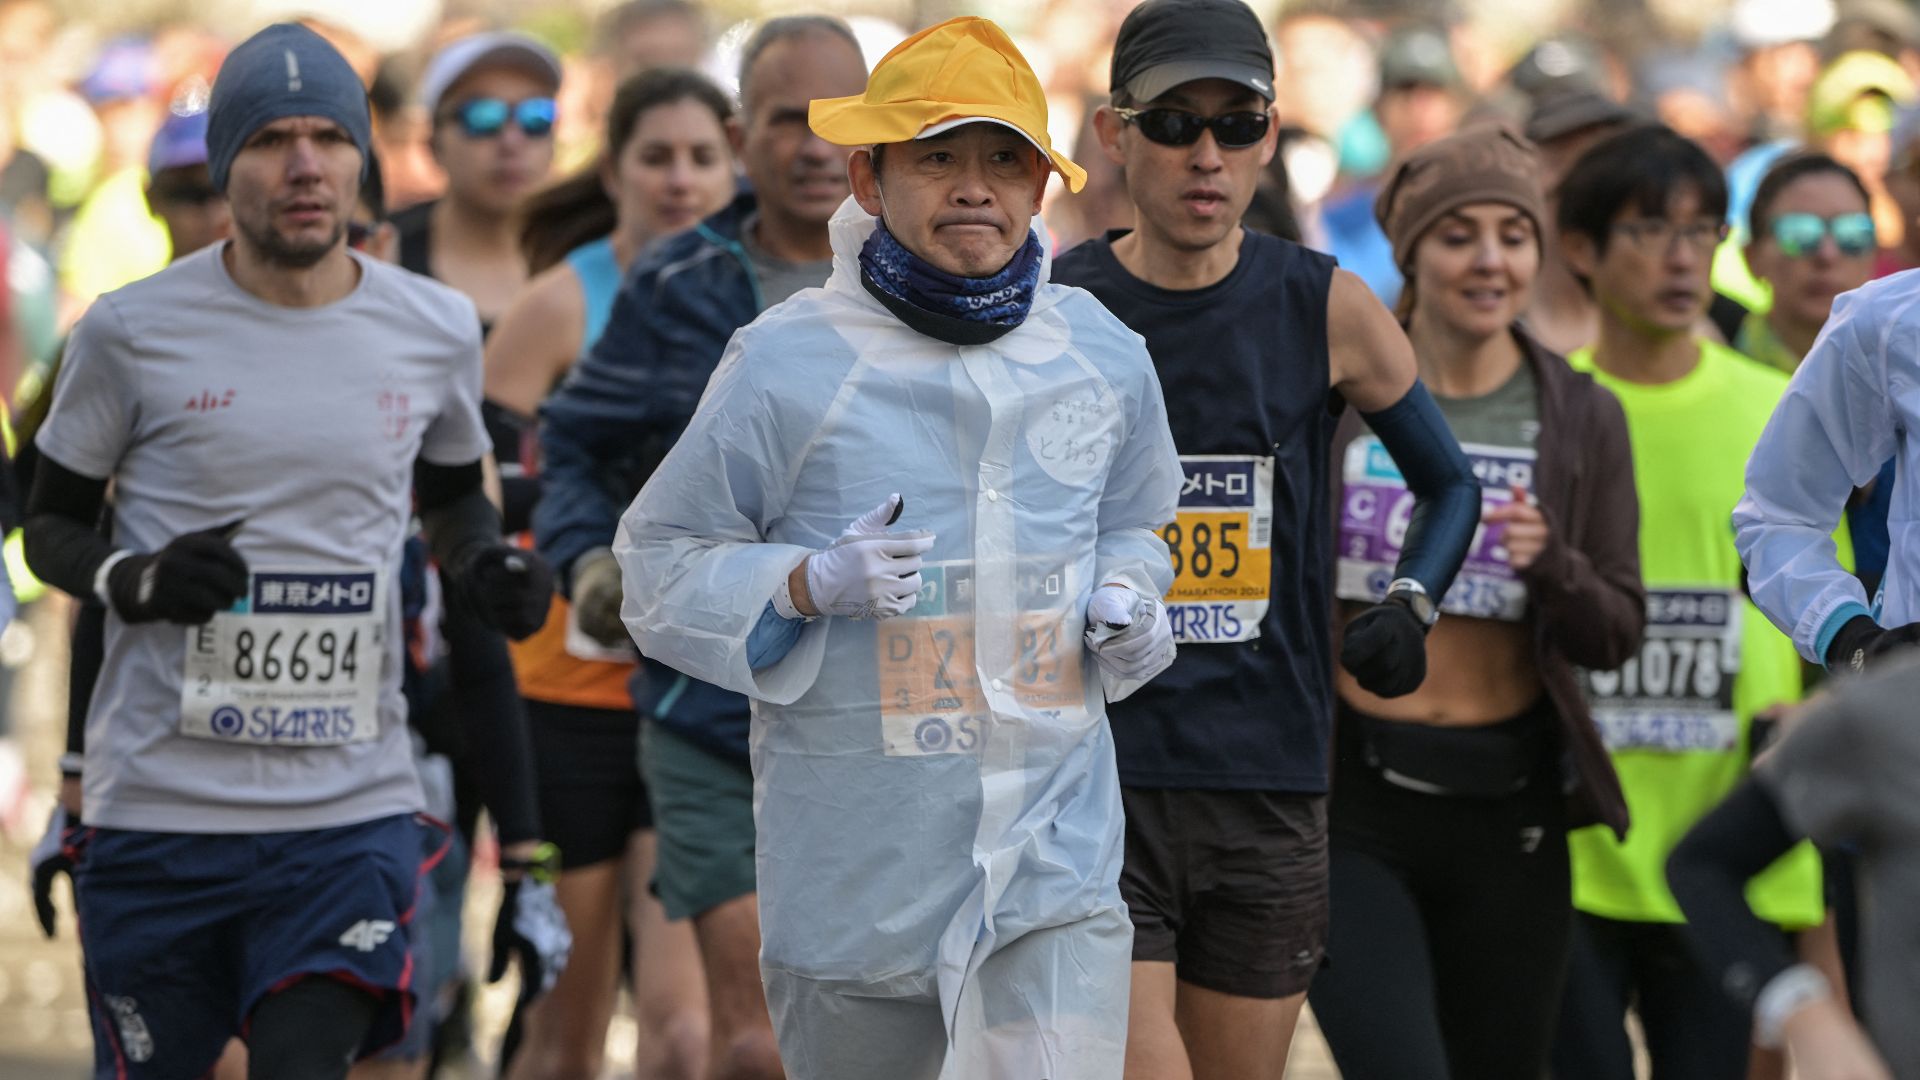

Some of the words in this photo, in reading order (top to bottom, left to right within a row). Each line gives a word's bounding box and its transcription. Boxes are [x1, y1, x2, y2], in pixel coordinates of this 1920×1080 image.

[1182, 473, 1248, 496] メトロ
[1349, 489, 1377, 521] C
[260, 581, 371, 606] 東京メトロ
[1177, 587, 1238, 598] MARATHON
[196, 625, 216, 655] E
[888, 634, 913, 662] D
[234, 628, 359, 681] 86694
[895, 687, 911, 709] 3
[339, 919, 396, 951] 4F
